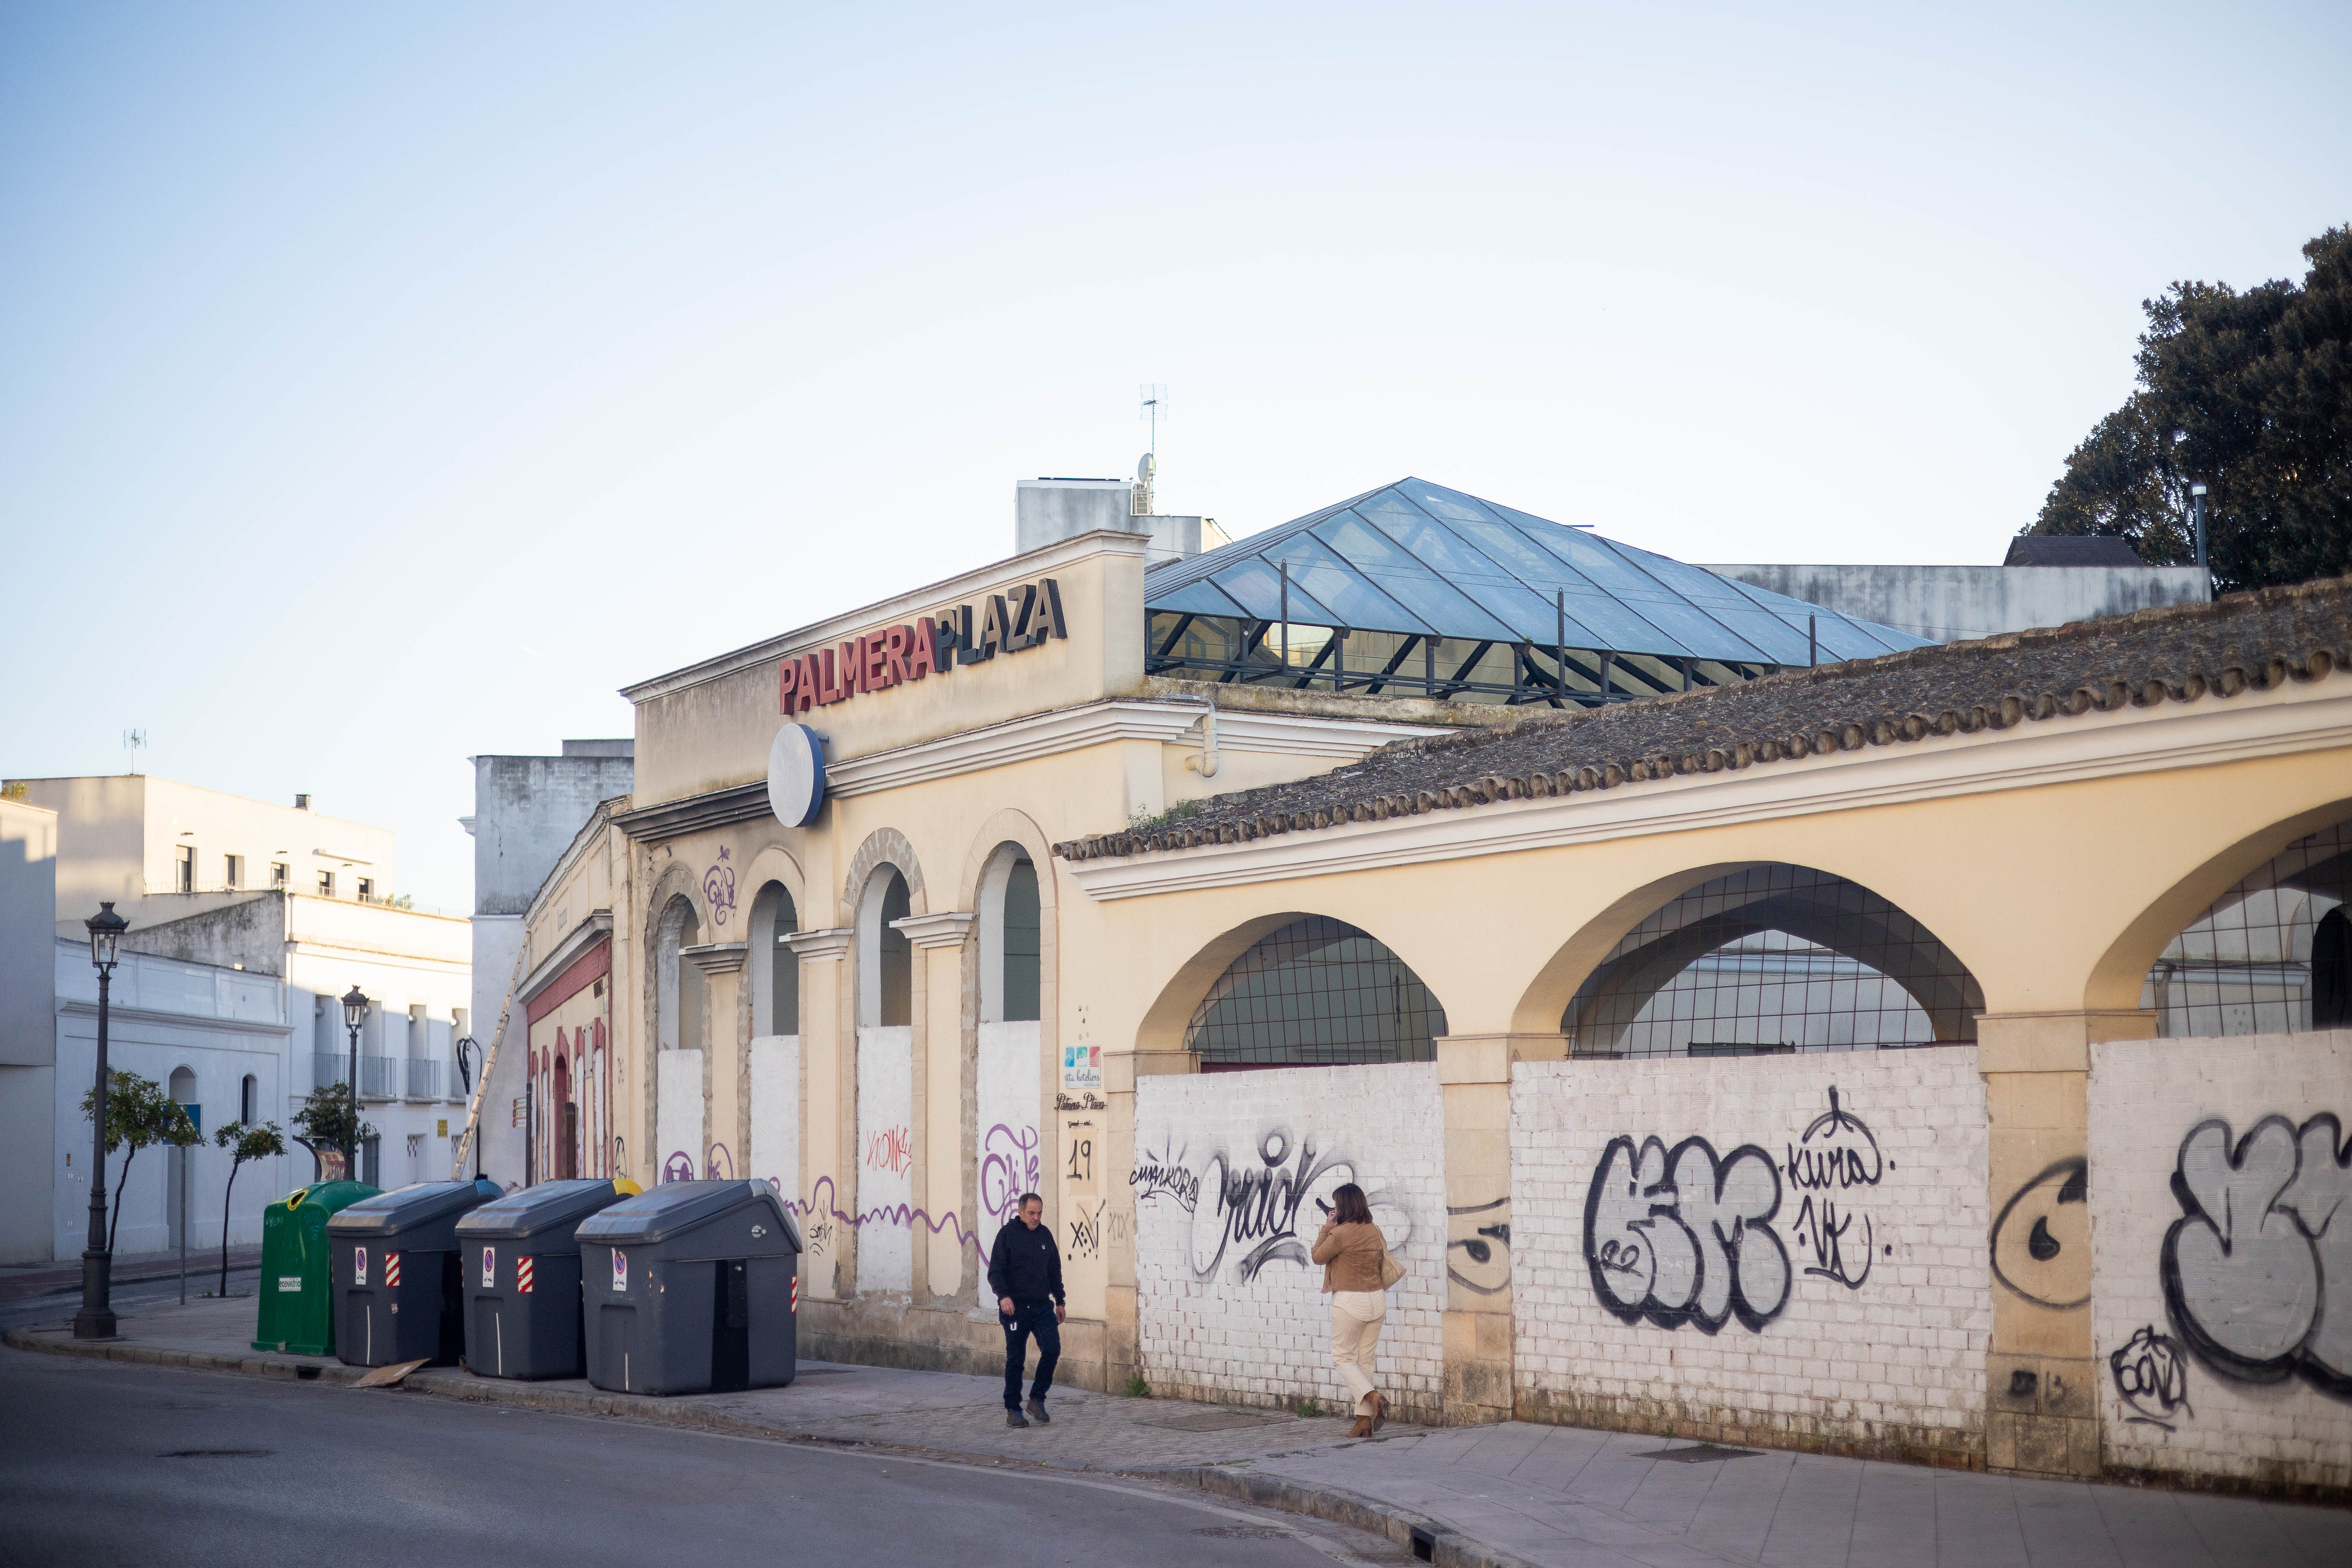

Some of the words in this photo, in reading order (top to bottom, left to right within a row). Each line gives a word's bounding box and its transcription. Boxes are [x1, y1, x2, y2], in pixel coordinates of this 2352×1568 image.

[1077, 1069, 1099, 1081] hoteliers
[1066, 1139, 1091, 1180] 19
[279, 1278, 301, 1288] ecovidrio
